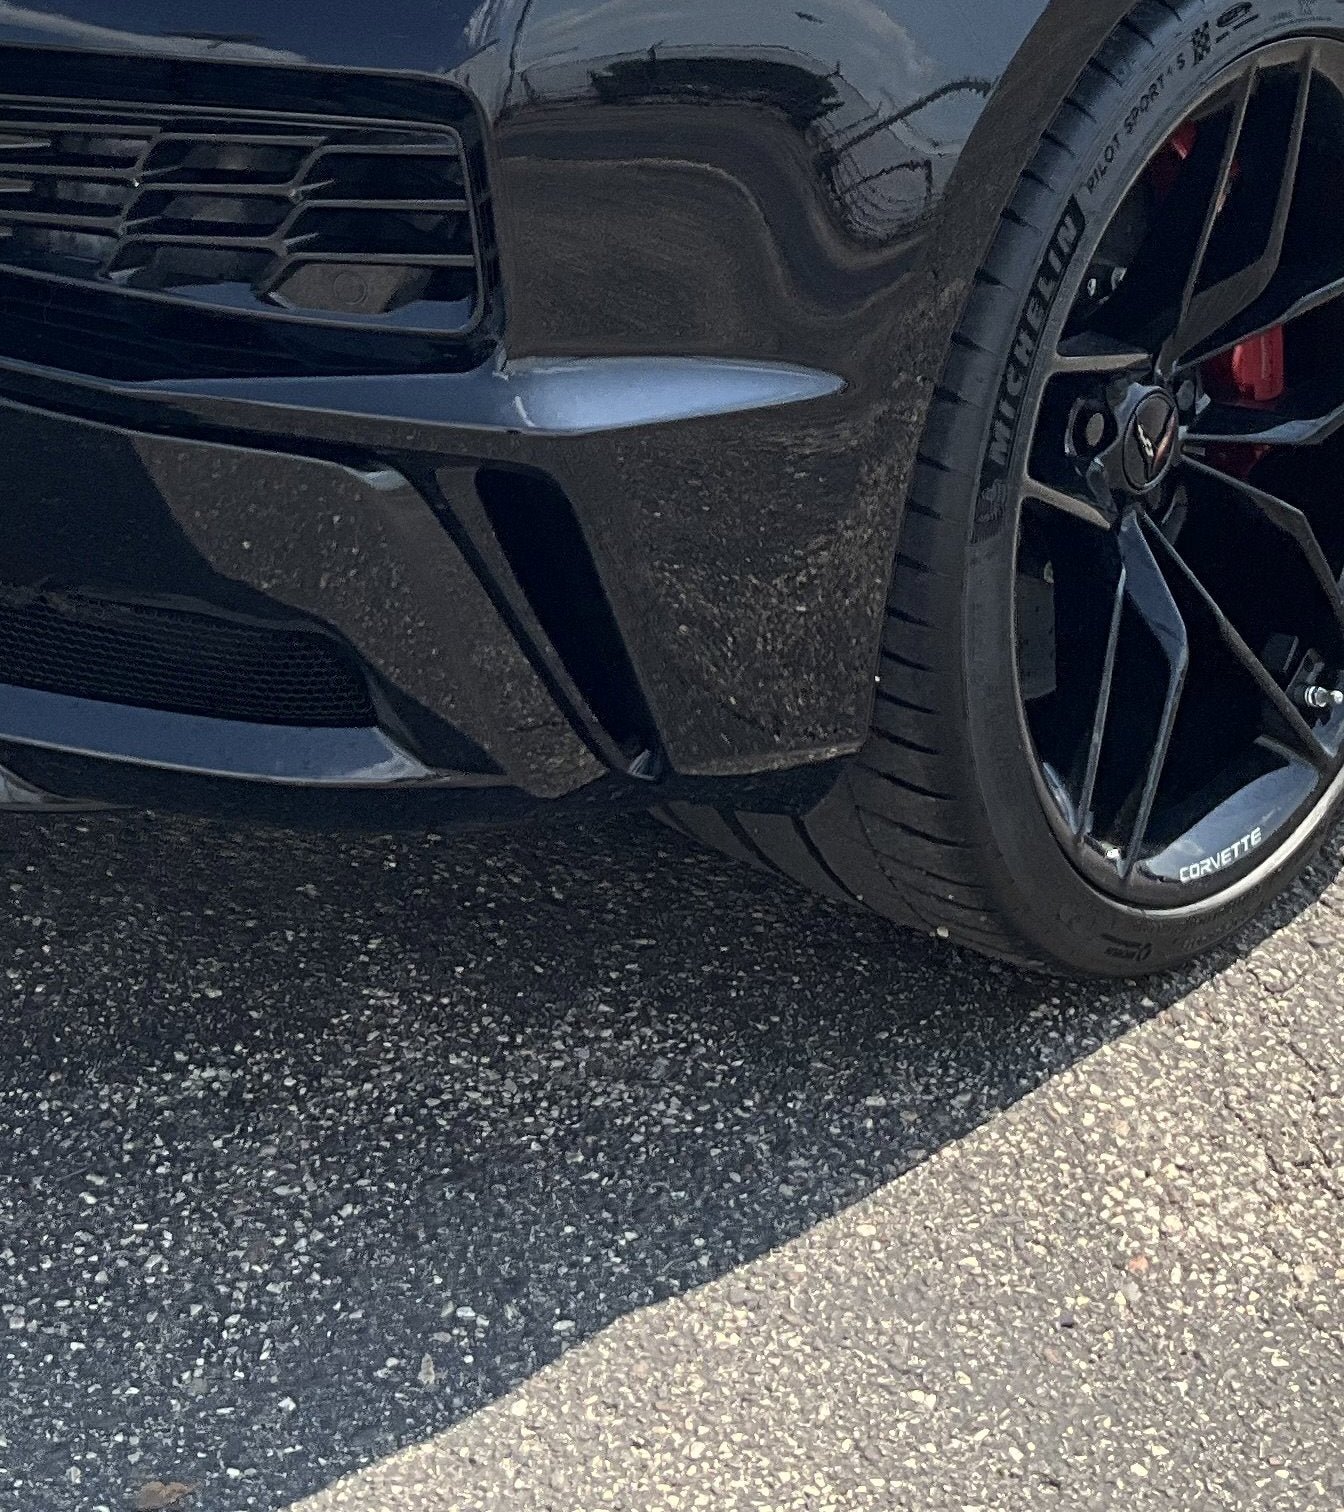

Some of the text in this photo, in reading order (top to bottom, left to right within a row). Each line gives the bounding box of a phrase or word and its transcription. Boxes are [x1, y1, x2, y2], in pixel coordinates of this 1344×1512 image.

[1085, 133, 1121, 195] PILOT
[1124, 73, 1165, 135] SPORT
[987, 214, 1078, 466] MICHELIN
[1179, 826, 1263, 884] CORVETTE
